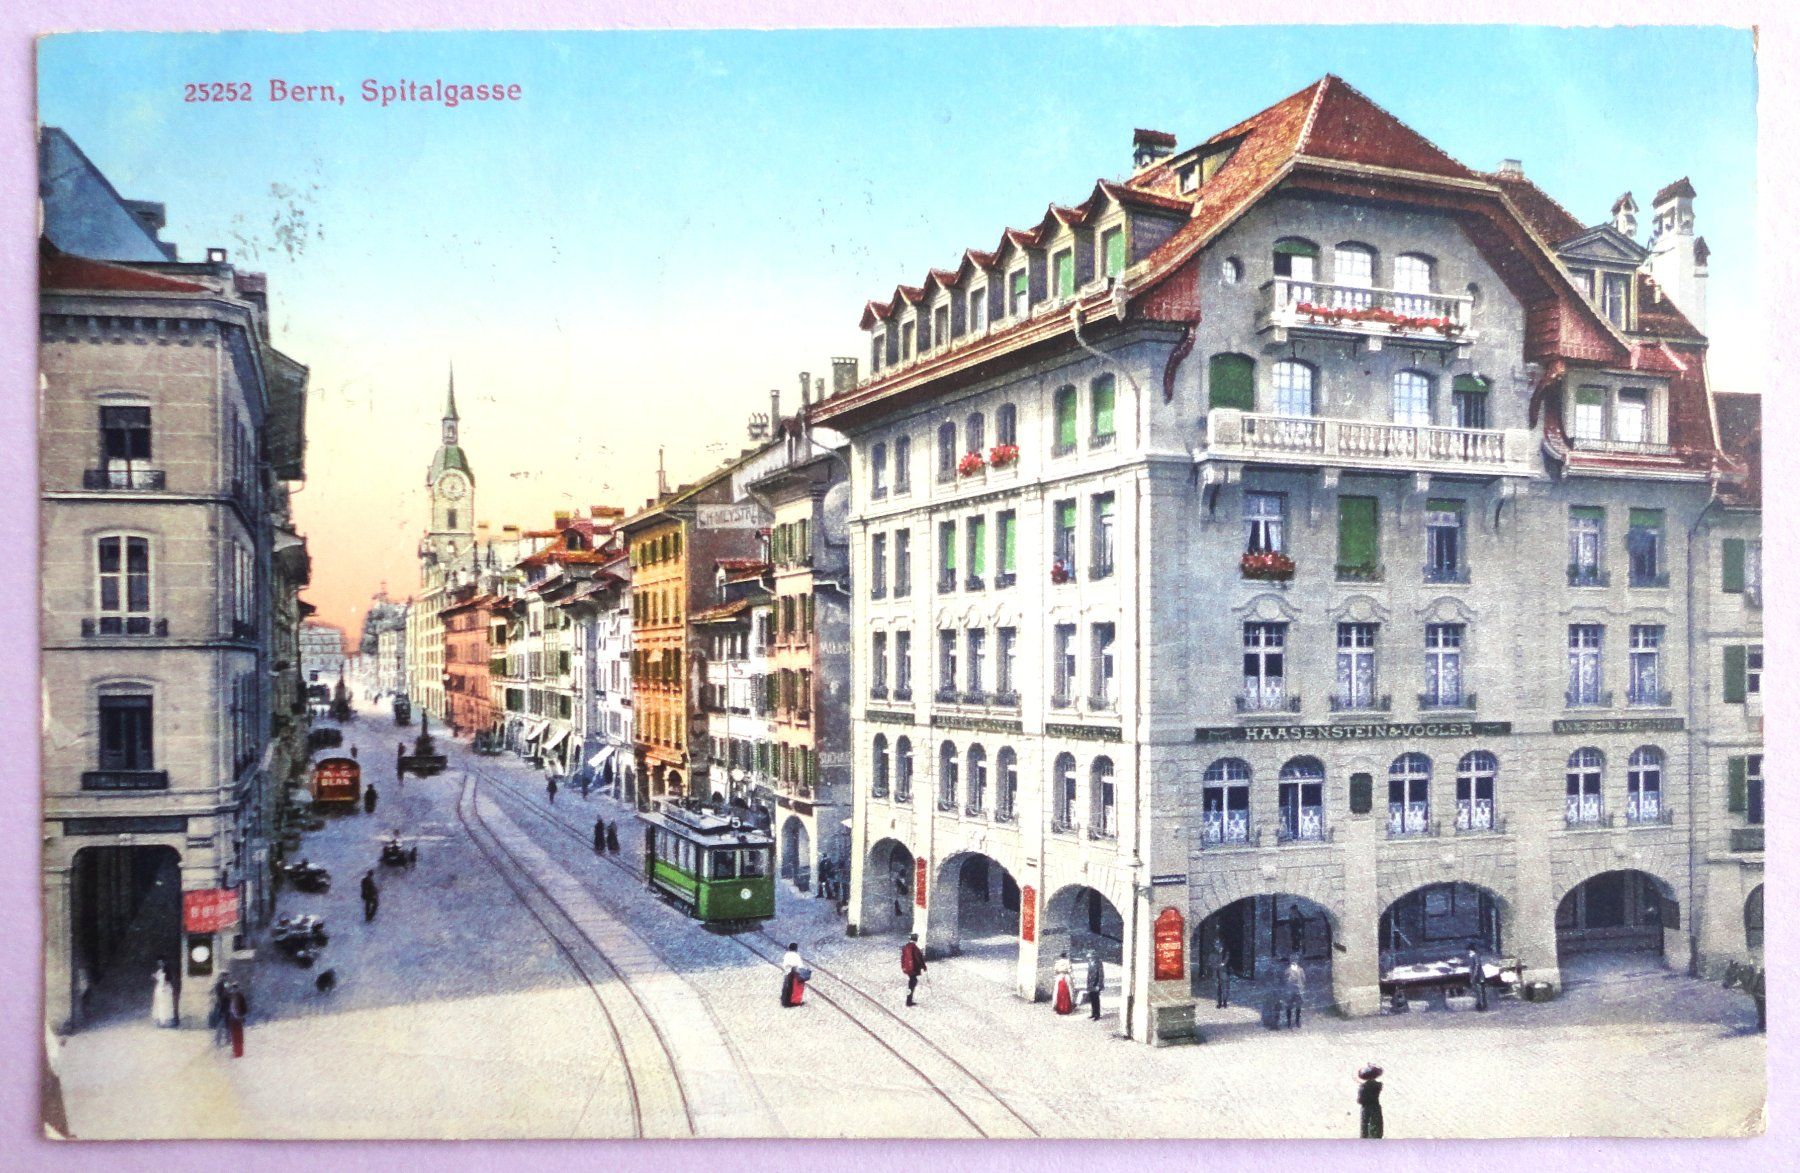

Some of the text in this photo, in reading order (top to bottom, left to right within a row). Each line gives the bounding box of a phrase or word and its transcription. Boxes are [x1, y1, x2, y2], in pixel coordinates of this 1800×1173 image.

[184, 79, 522, 107] 25252 Bern, Spitalgasse
